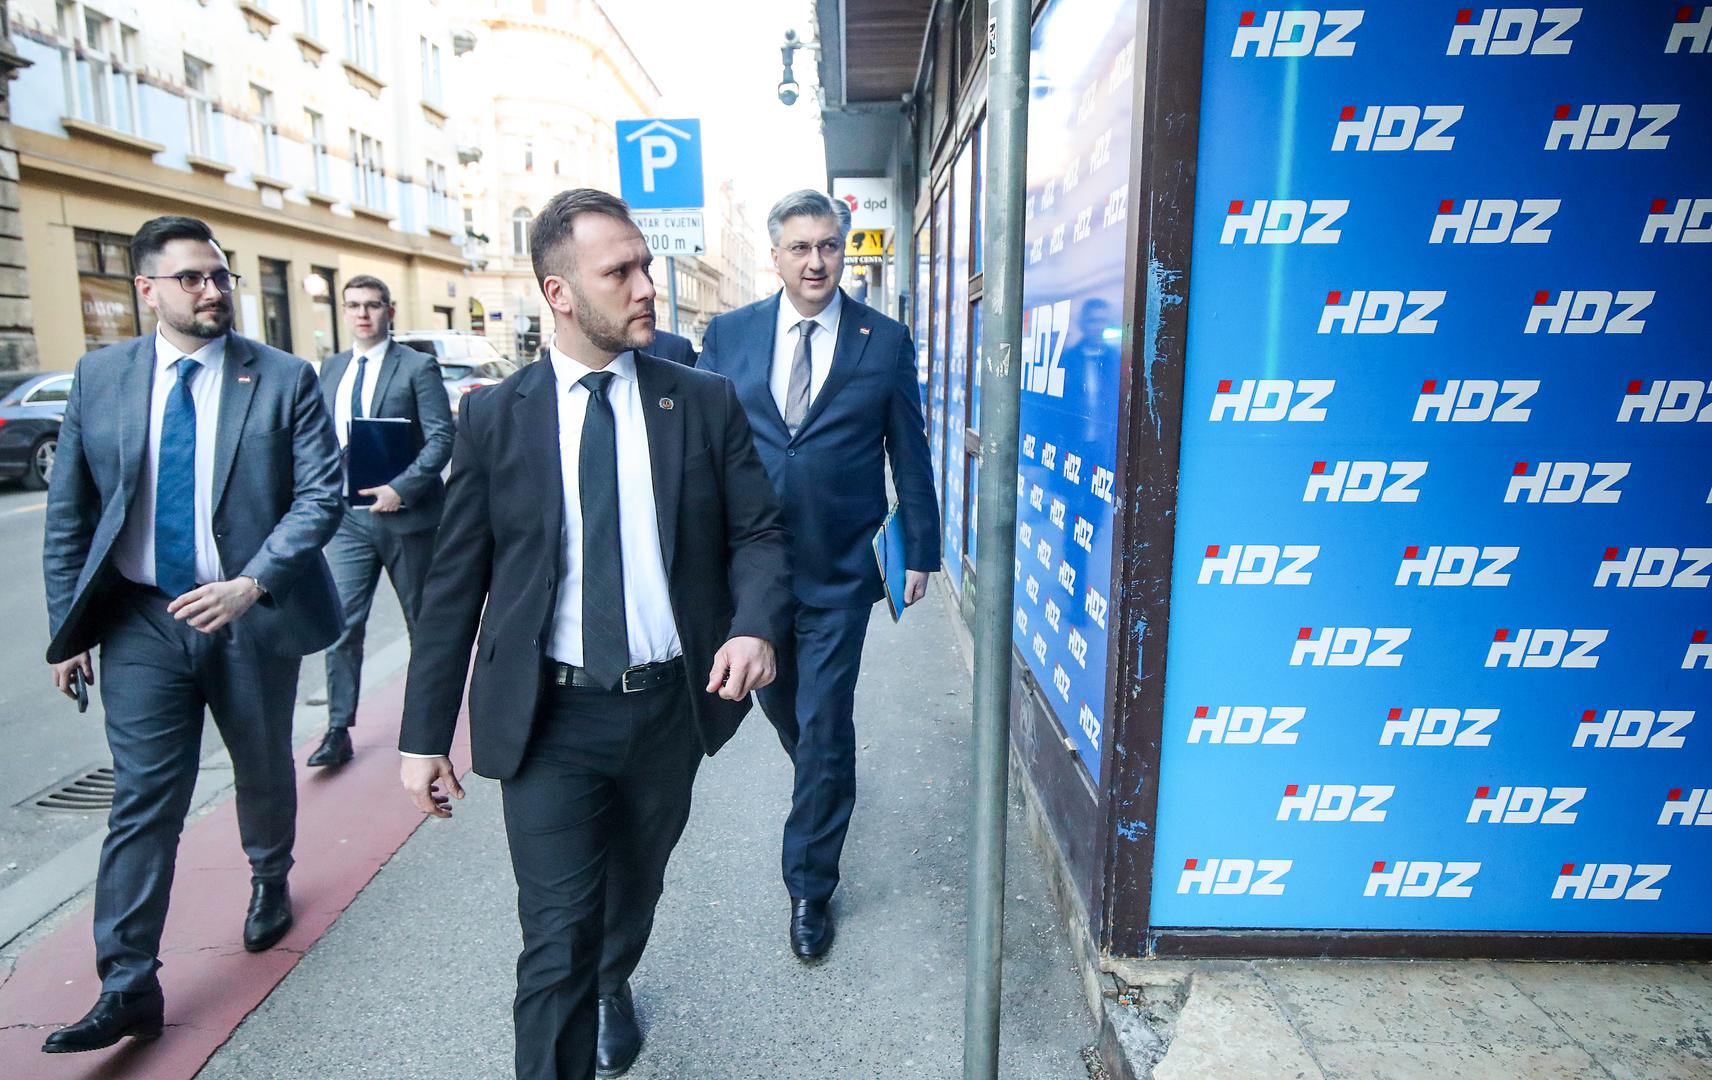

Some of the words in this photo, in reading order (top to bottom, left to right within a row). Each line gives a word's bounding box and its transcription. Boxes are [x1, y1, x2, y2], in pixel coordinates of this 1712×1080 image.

[1231, 11, 1364, 57] HDZ
[1447, 9, 1582, 55] HDZ
[1332, 106, 1464, 151] HDZ
[1545, 105, 1680, 150] HDZ
[641, 135, 677, 192] P
[664, 217, 700, 228] CVJETNI
[863, 198, 887, 212] dpd
[1073, 205, 1092, 244] HDZ
[1103, 184, 1128, 229] HDZ
[1220, 200, 1350, 244] HDZ
[1430, 200, 1561, 244] HDZ
[1640, 200, 1712, 243] HD
[675, 238, 686, 250] m
[1318, 291, 1446, 334] HDZ
[1524, 291, 1655, 334] HDZ
[1021, 299, 1071, 398] HDZ
[1210, 380, 1336, 422] HDZ
[1413, 380, 1540, 422] HDZ
[1617, 381, 1712, 422] HD
[1042, 442, 1057, 471] HDZ
[1063, 451, 1082, 485] HDZ
[1091, 464, 1115, 504] HDZ
[1303, 461, 1428, 502] HDZ
[1504, 462, 1631, 503] HDZ
[1050, 498, 1066, 530] HDZ
[1074, 515, 1094, 554] HDZ
[1037, 539, 1052, 571] HDZ
[1197, 545, 1320, 585] HDZ
[1395, 546, 1520, 586] HDZ
[1594, 547, 1712, 588] HDZ
[1059, 560, 1076, 597] HDZ
[1045, 598, 1061, 635] HDZ
[1085, 585, 1108, 631] HDZ
[1033, 631, 1048, 667] HDZ
[1068, 625, 1088, 670] HDZ
[1290, 627, 1412, 666] HDZ
[1485, 629, 1608, 668] HDZ
[1054, 662, 1071, 704] HDZ
[1079, 701, 1101, 752] HDZ
[1187, 706, 1306, 744] HDZ
[1379, 708, 1500, 746] HDZ
[1573, 710, 1695, 748] HDZ
[1276, 784, 1395, 822] HDZ
[1466, 787, 1587, 824] HDZ
[1176, 858, 1293, 895] HDZ
[1363, 861, 1482, 898] HDZ
[1552, 864, 1671, 900] HDZ
